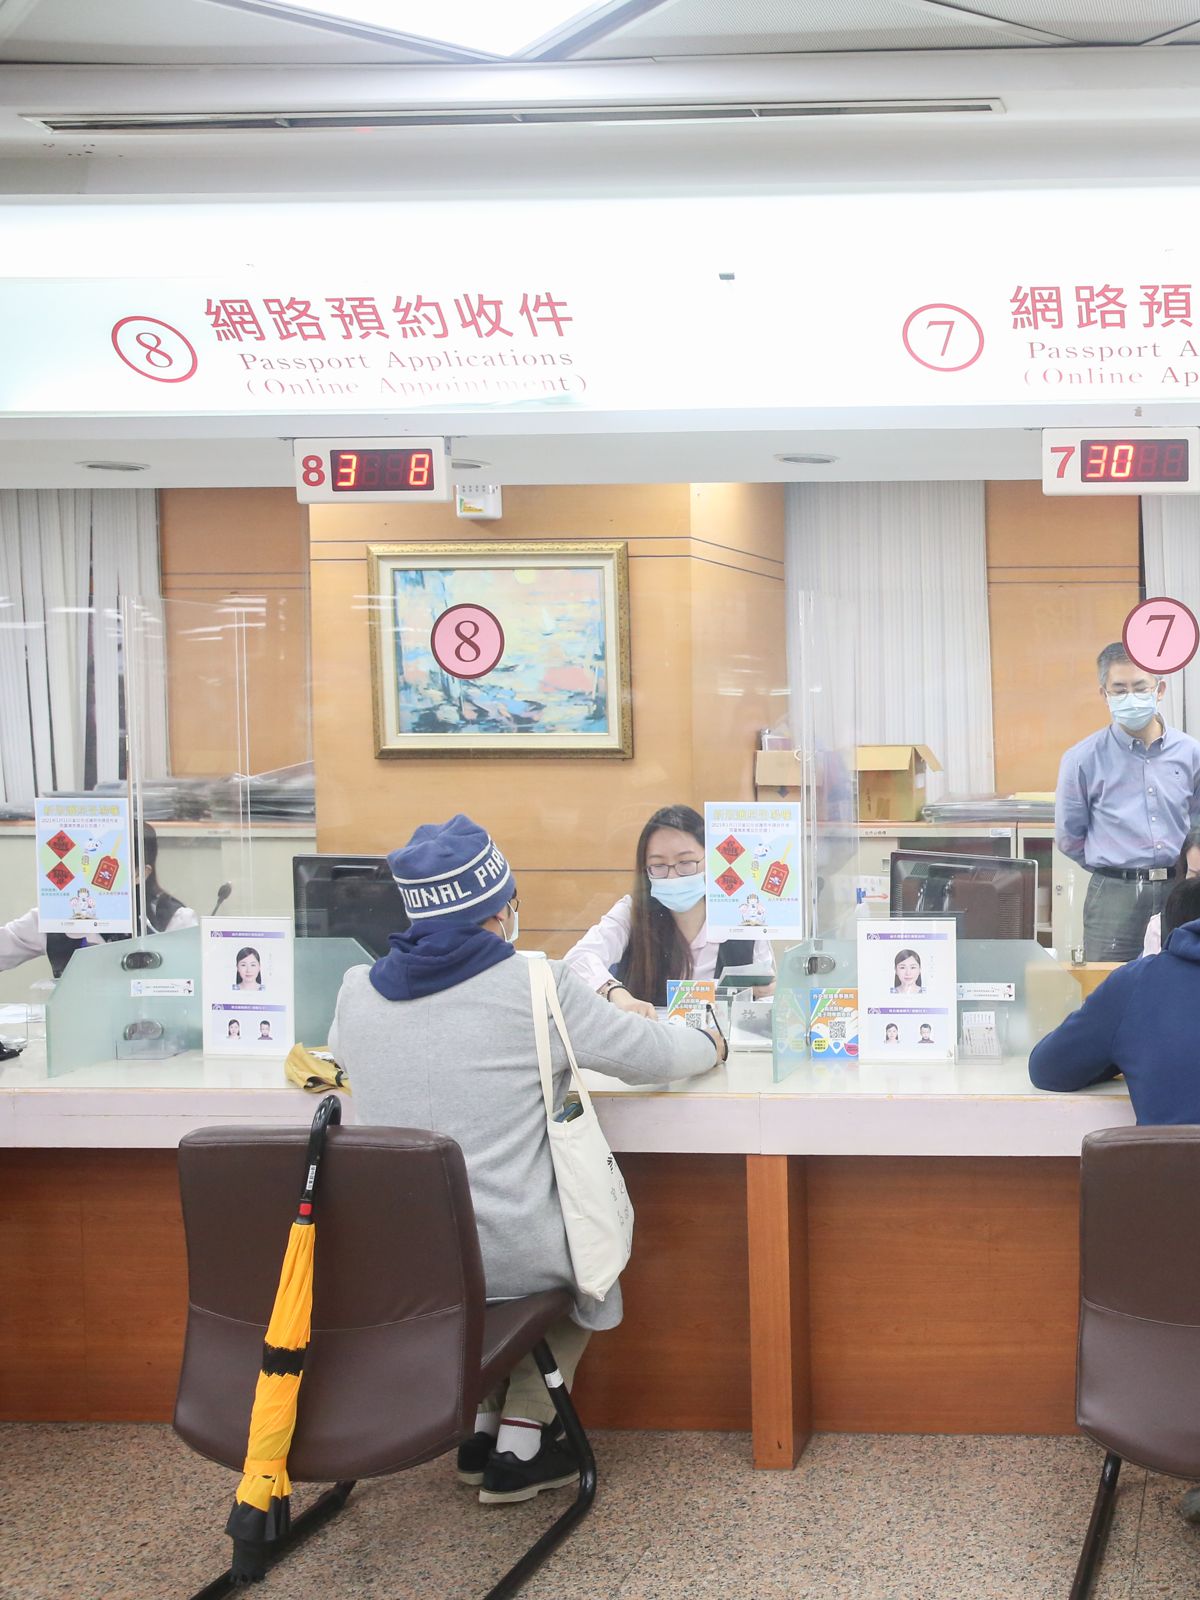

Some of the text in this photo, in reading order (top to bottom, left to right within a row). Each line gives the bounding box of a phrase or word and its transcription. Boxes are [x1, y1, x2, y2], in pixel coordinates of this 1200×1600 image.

[204, 292, 574, 344] 網路預約收件
[136, 332, 174, 369] 8
[926, 320, 955, 356] 7
[1027, 340, 1162, 363] Passport
[239, 347, 574, 374] Passport Applications
[301, 455, 326, 487] 8
[1050, 446, 1076, 479] 7
[454, 620, 482, 663] 8
[1145, 615, 1176, 657] 7
[400, 880, 472, 908] IONAL
